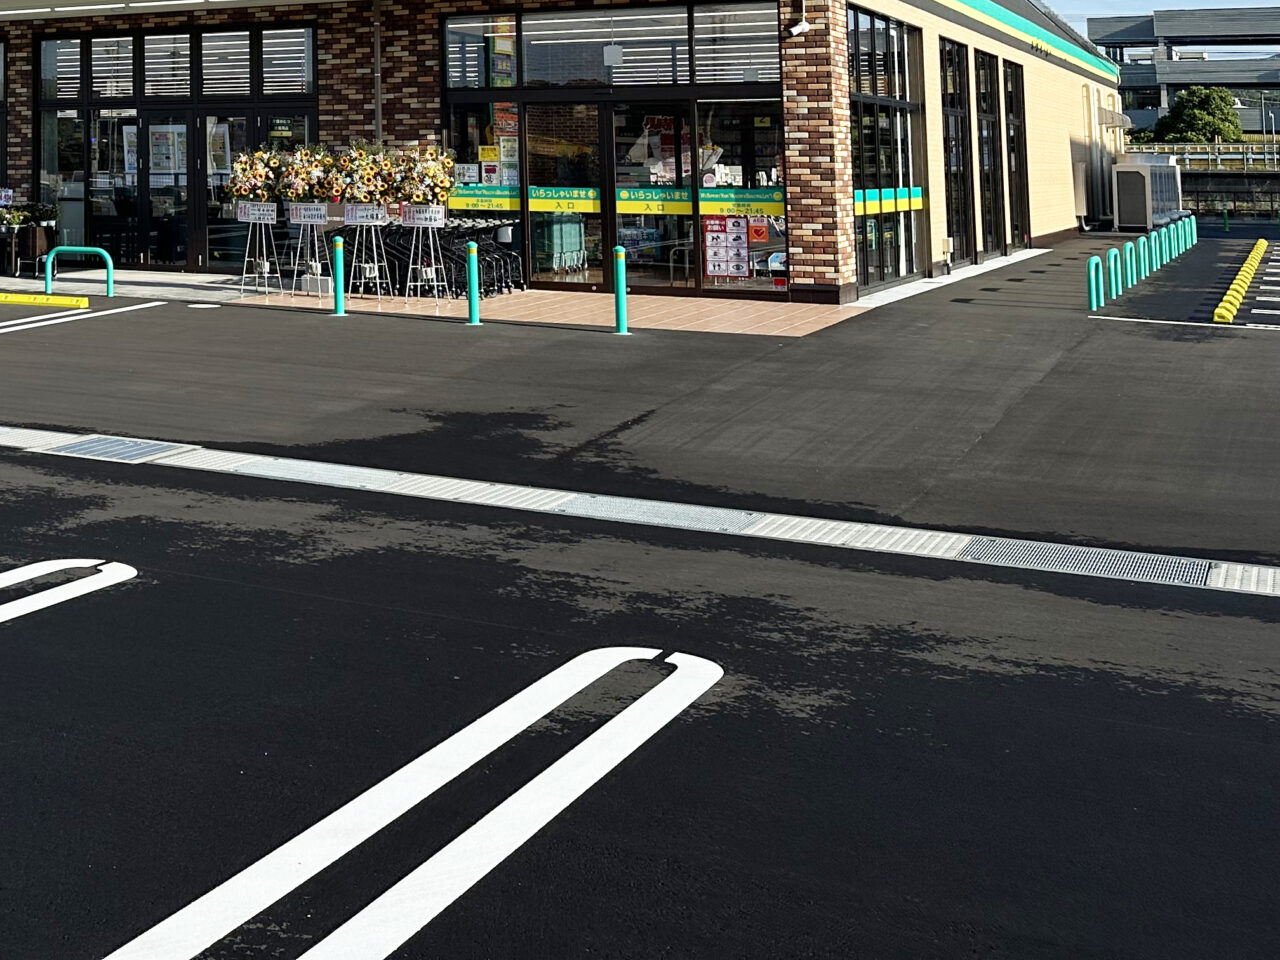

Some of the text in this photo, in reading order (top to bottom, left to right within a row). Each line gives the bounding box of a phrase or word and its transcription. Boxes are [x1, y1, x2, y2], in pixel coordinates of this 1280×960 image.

[531, 189, 587, 198] いらっしゃいませ
[631, 191, 688, 200] いらっしゃいませ
[555, 201, 575, 209] 入口
[644, 203, 665, 211] 入口
